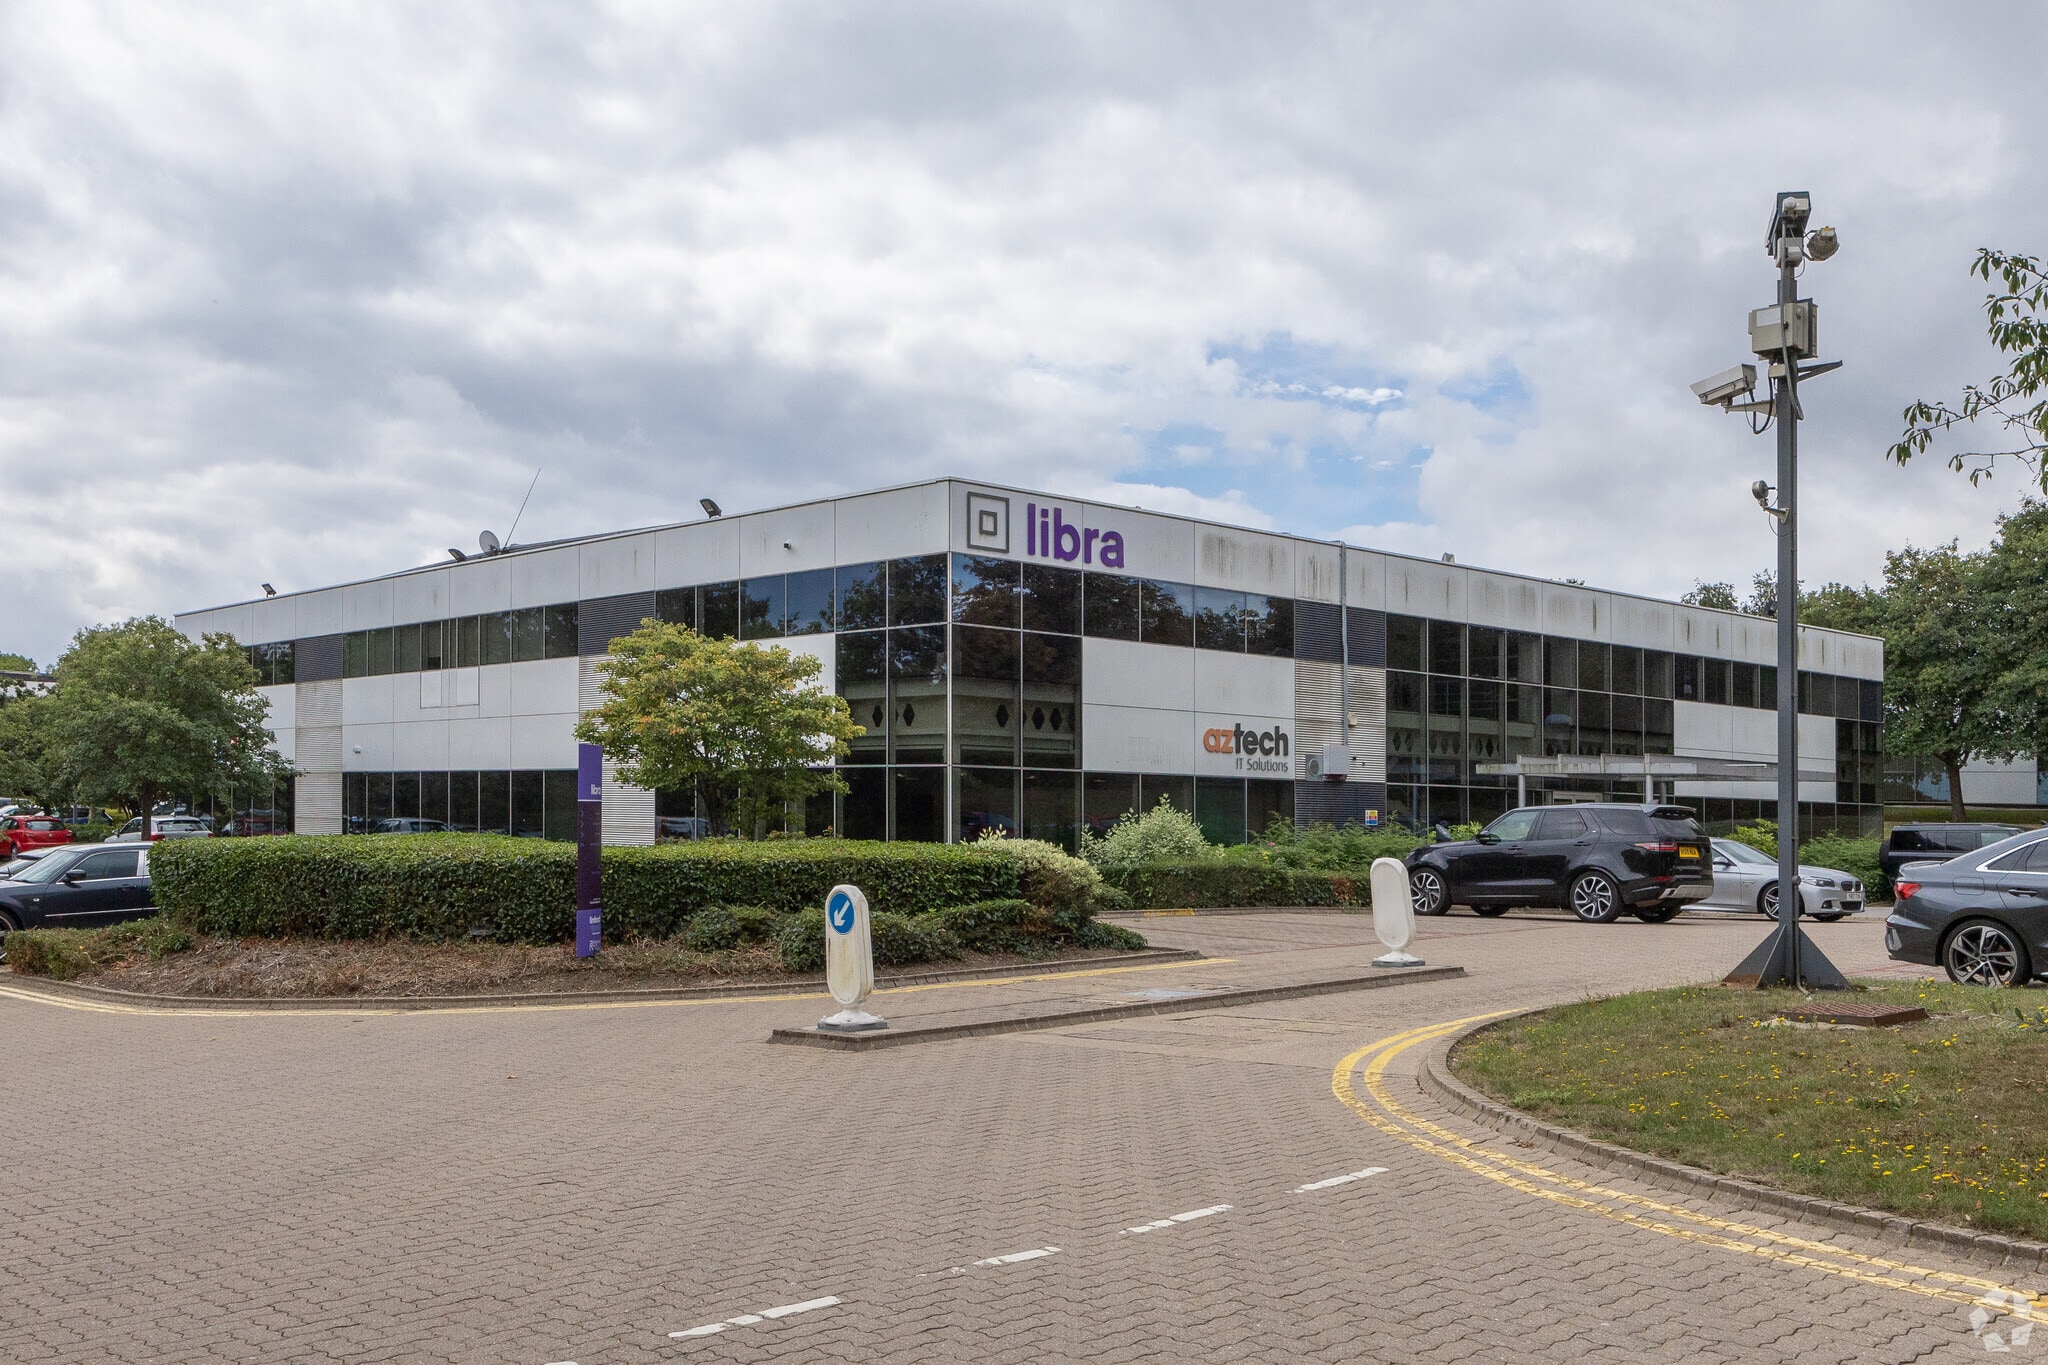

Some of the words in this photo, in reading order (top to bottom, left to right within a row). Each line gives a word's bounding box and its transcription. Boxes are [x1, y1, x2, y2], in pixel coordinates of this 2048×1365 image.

[1028, 503, 1124, 568] libra
[1203, 722, 1289, 757] aztech
[1236, 757, 1244, 770] IT
[1247, 758, 1289, 773] Solutions
